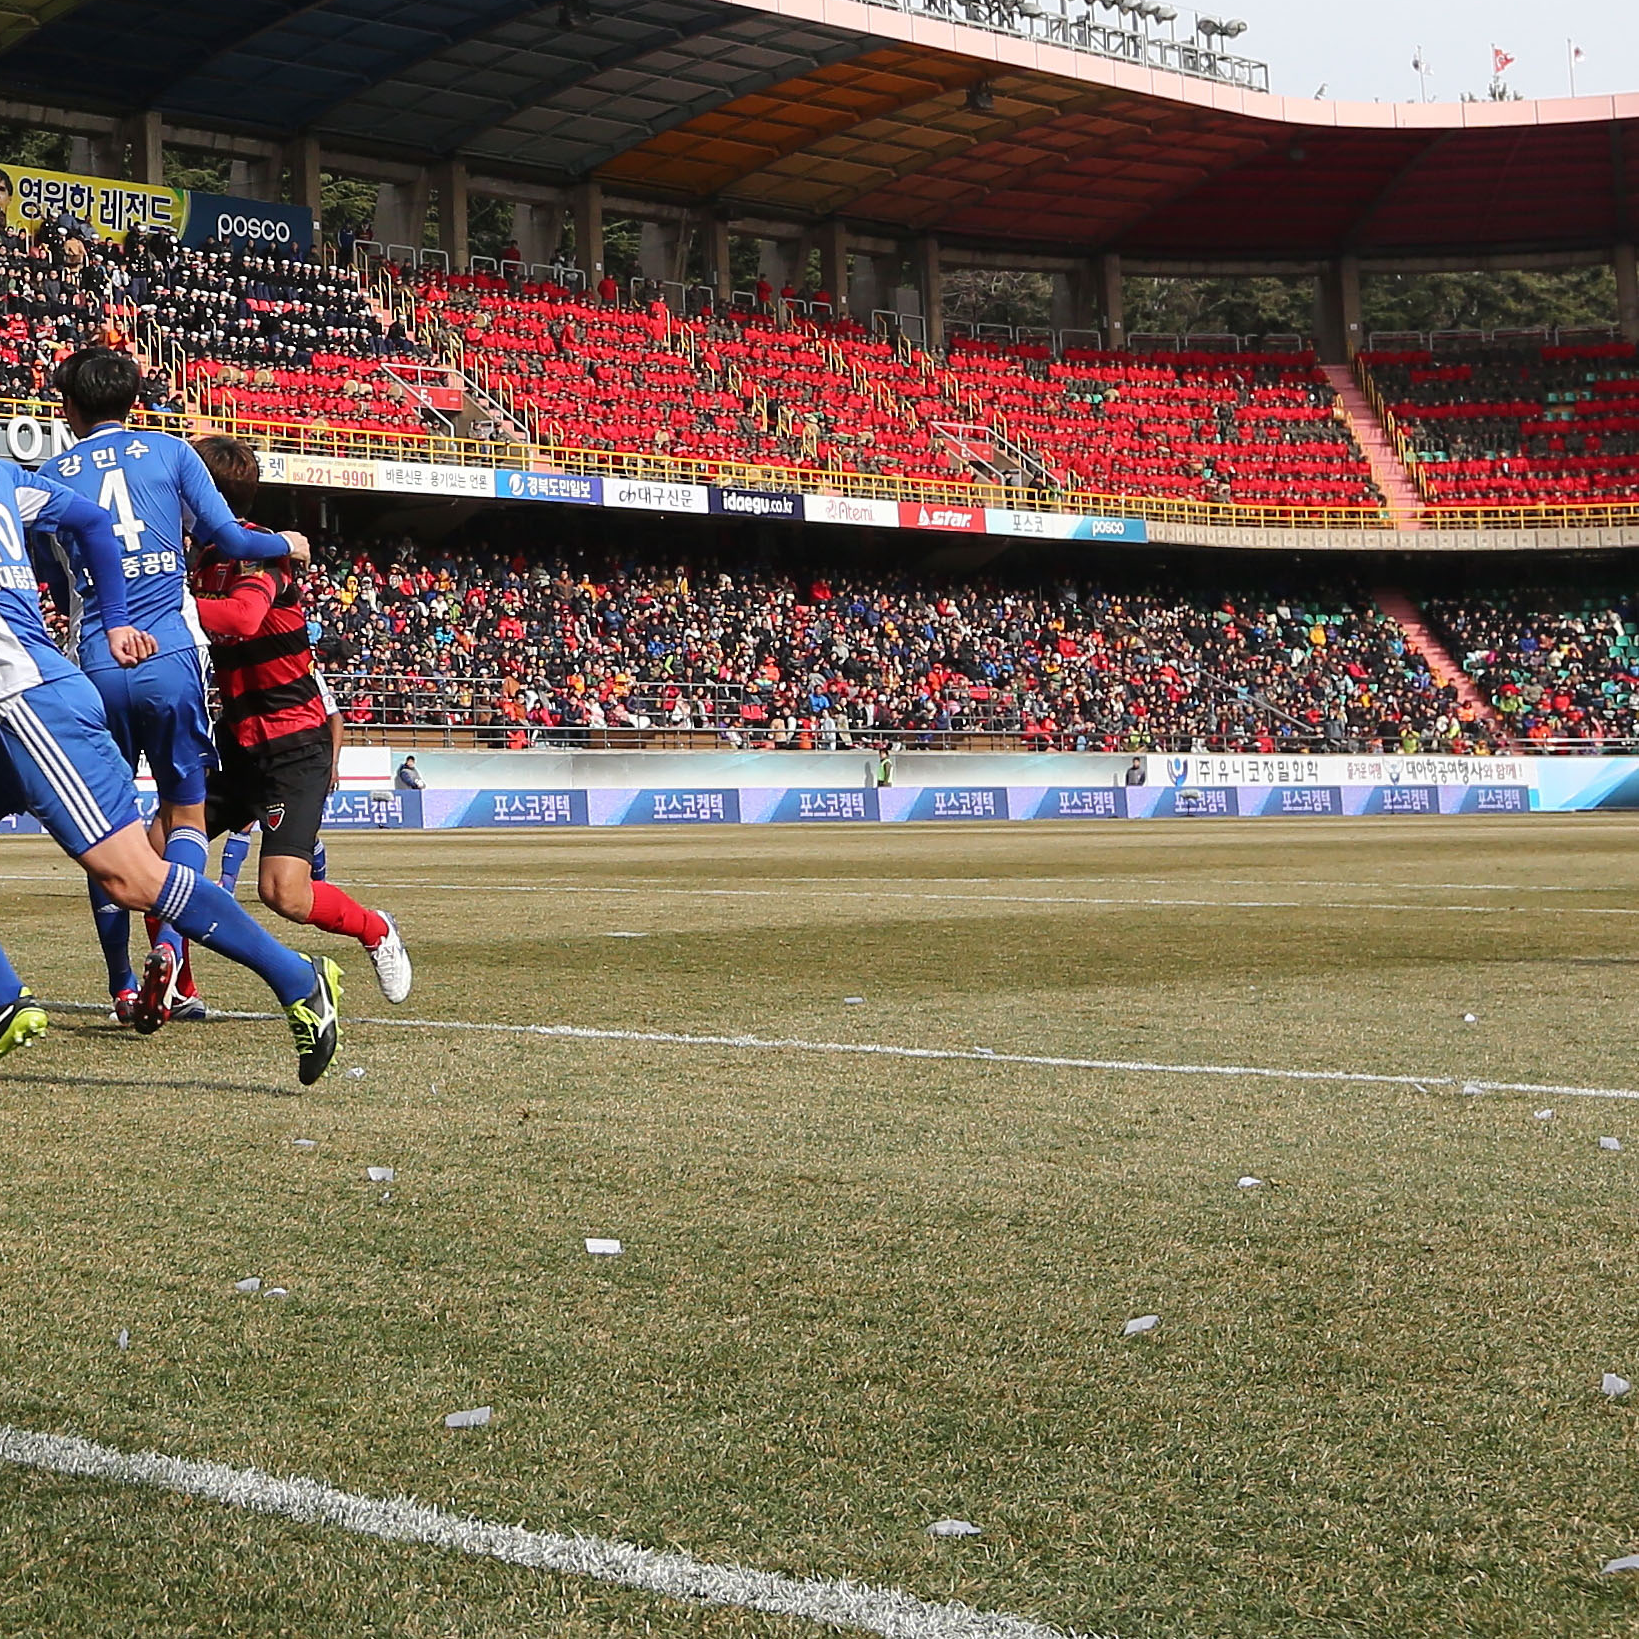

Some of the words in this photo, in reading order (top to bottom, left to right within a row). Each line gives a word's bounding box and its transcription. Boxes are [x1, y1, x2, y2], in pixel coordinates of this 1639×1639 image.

[18, 177, 95, 227] 영원한
[100, 188, 174, 234] 레전드
[217, 213, 291, 243] posco
[305, 467, 375, 487] 221-9901
[385, 469, 423, 486] 바른신문
[430, 471, 466, 489] 용기있는
[469, 473, 488, 490] 언론
[526, 475, 591, 500] 경북도민일보
[638, 487, 694, 508] 대구신문
[98, 468, 146, 553] 4
[1012, 513, 1044, 533] 포스코
[1092, 520, 1125, 536] posco
[493, 794, 571, 823] 포스코켐텍
[653, 793, 724, 821] 포스코켐텍
[800, 793, 864, 819] 포스코켐텍
[934, 792, 995, 818] 포스코켐텍
[1058, 792, 1115, 815] 포스코켐텍
[1282, 790, 1331, 811] 포스코켐텍
[1383, 789, 1429, 810] 포스코켐텍
[1478, 789, 1522, 810] 포스코켐텍
